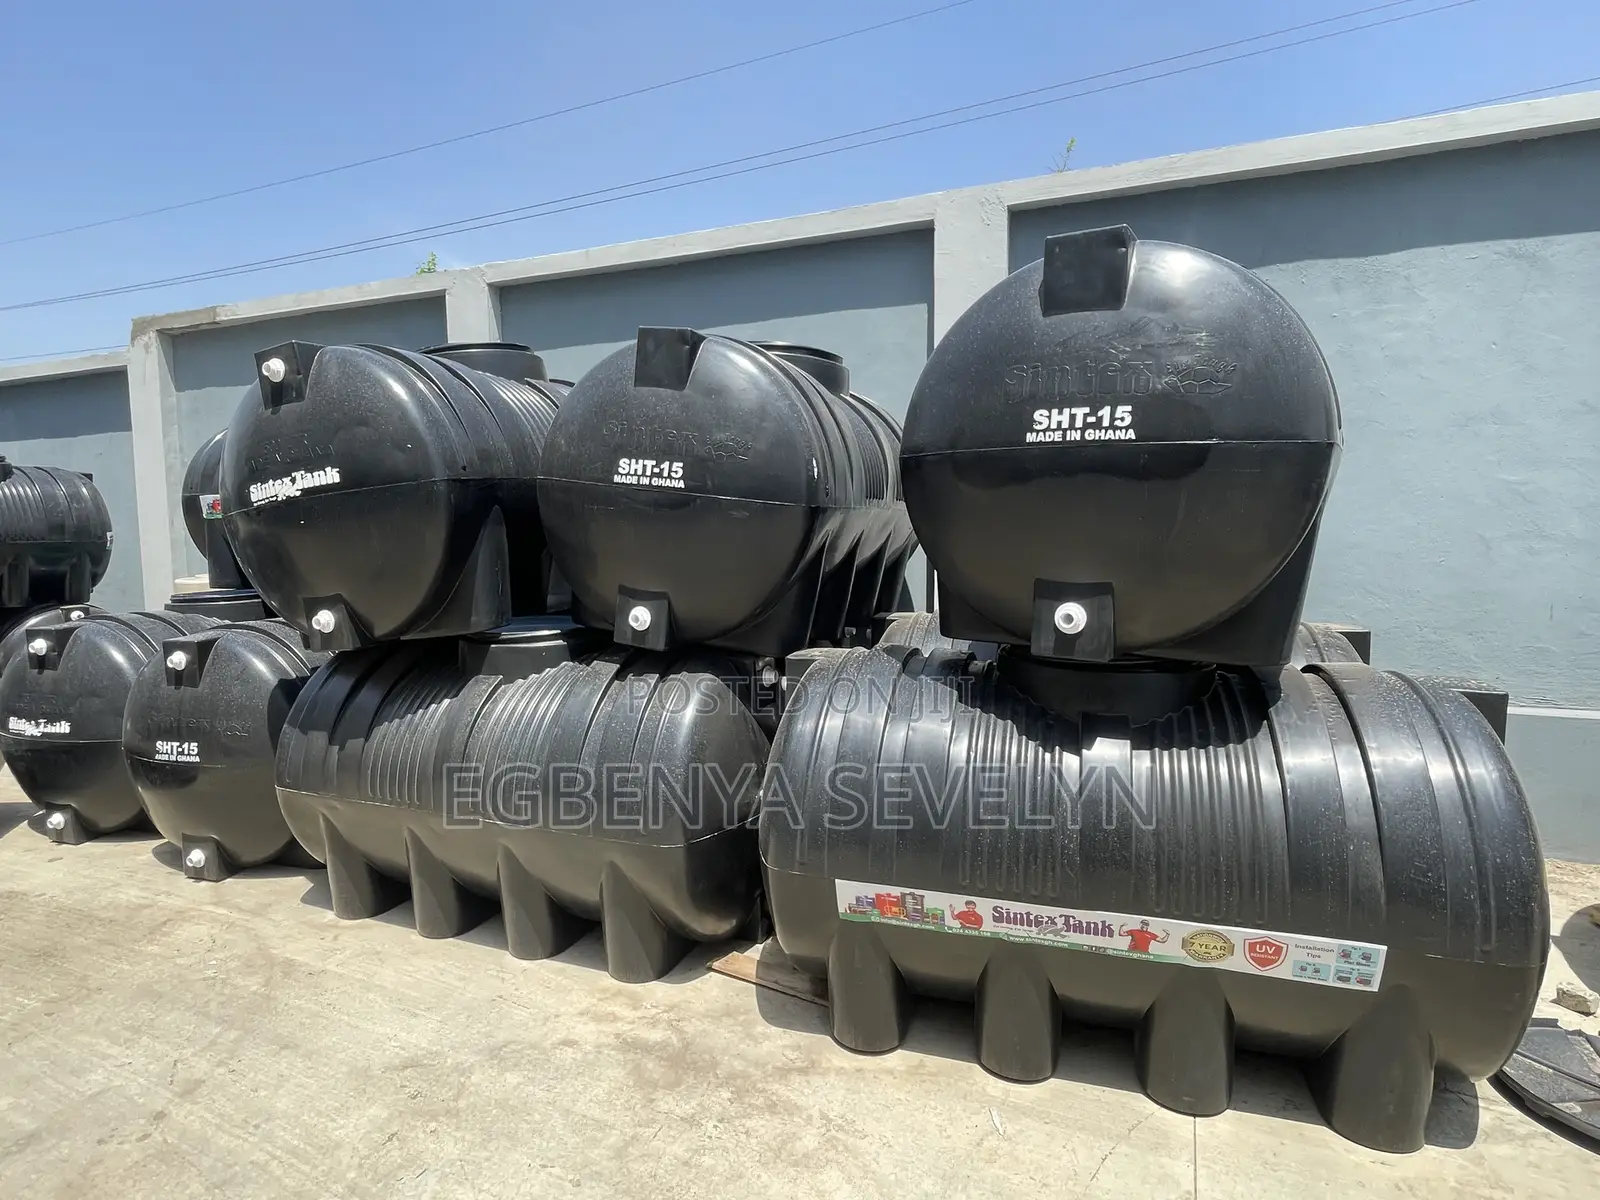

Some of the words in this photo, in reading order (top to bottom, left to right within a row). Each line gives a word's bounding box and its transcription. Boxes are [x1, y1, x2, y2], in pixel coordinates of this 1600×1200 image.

[1032, 405, 1133, 430] SHT-15
[1026, 430, 1063, 443] MADE
[1066, 429, 1081, 441] IN
[1084, 428, 1136, 441] GHANA
[618, 457, 684, 479] SHT-15
[613, 474, 638, 485] MADE
[639, 476, 650, 486] IN
[651, 477, 685, 489] GHANA
[155, 740, 199, 756] SHT-15
[154, 754, 170, 762] MADE
[177, 755, 200, 764] GHANA
[1198, 942, 1227, 952] YEAR
[1255, 943, 1276, 954] UV
[1294, 943, 1335, 953] Installation
